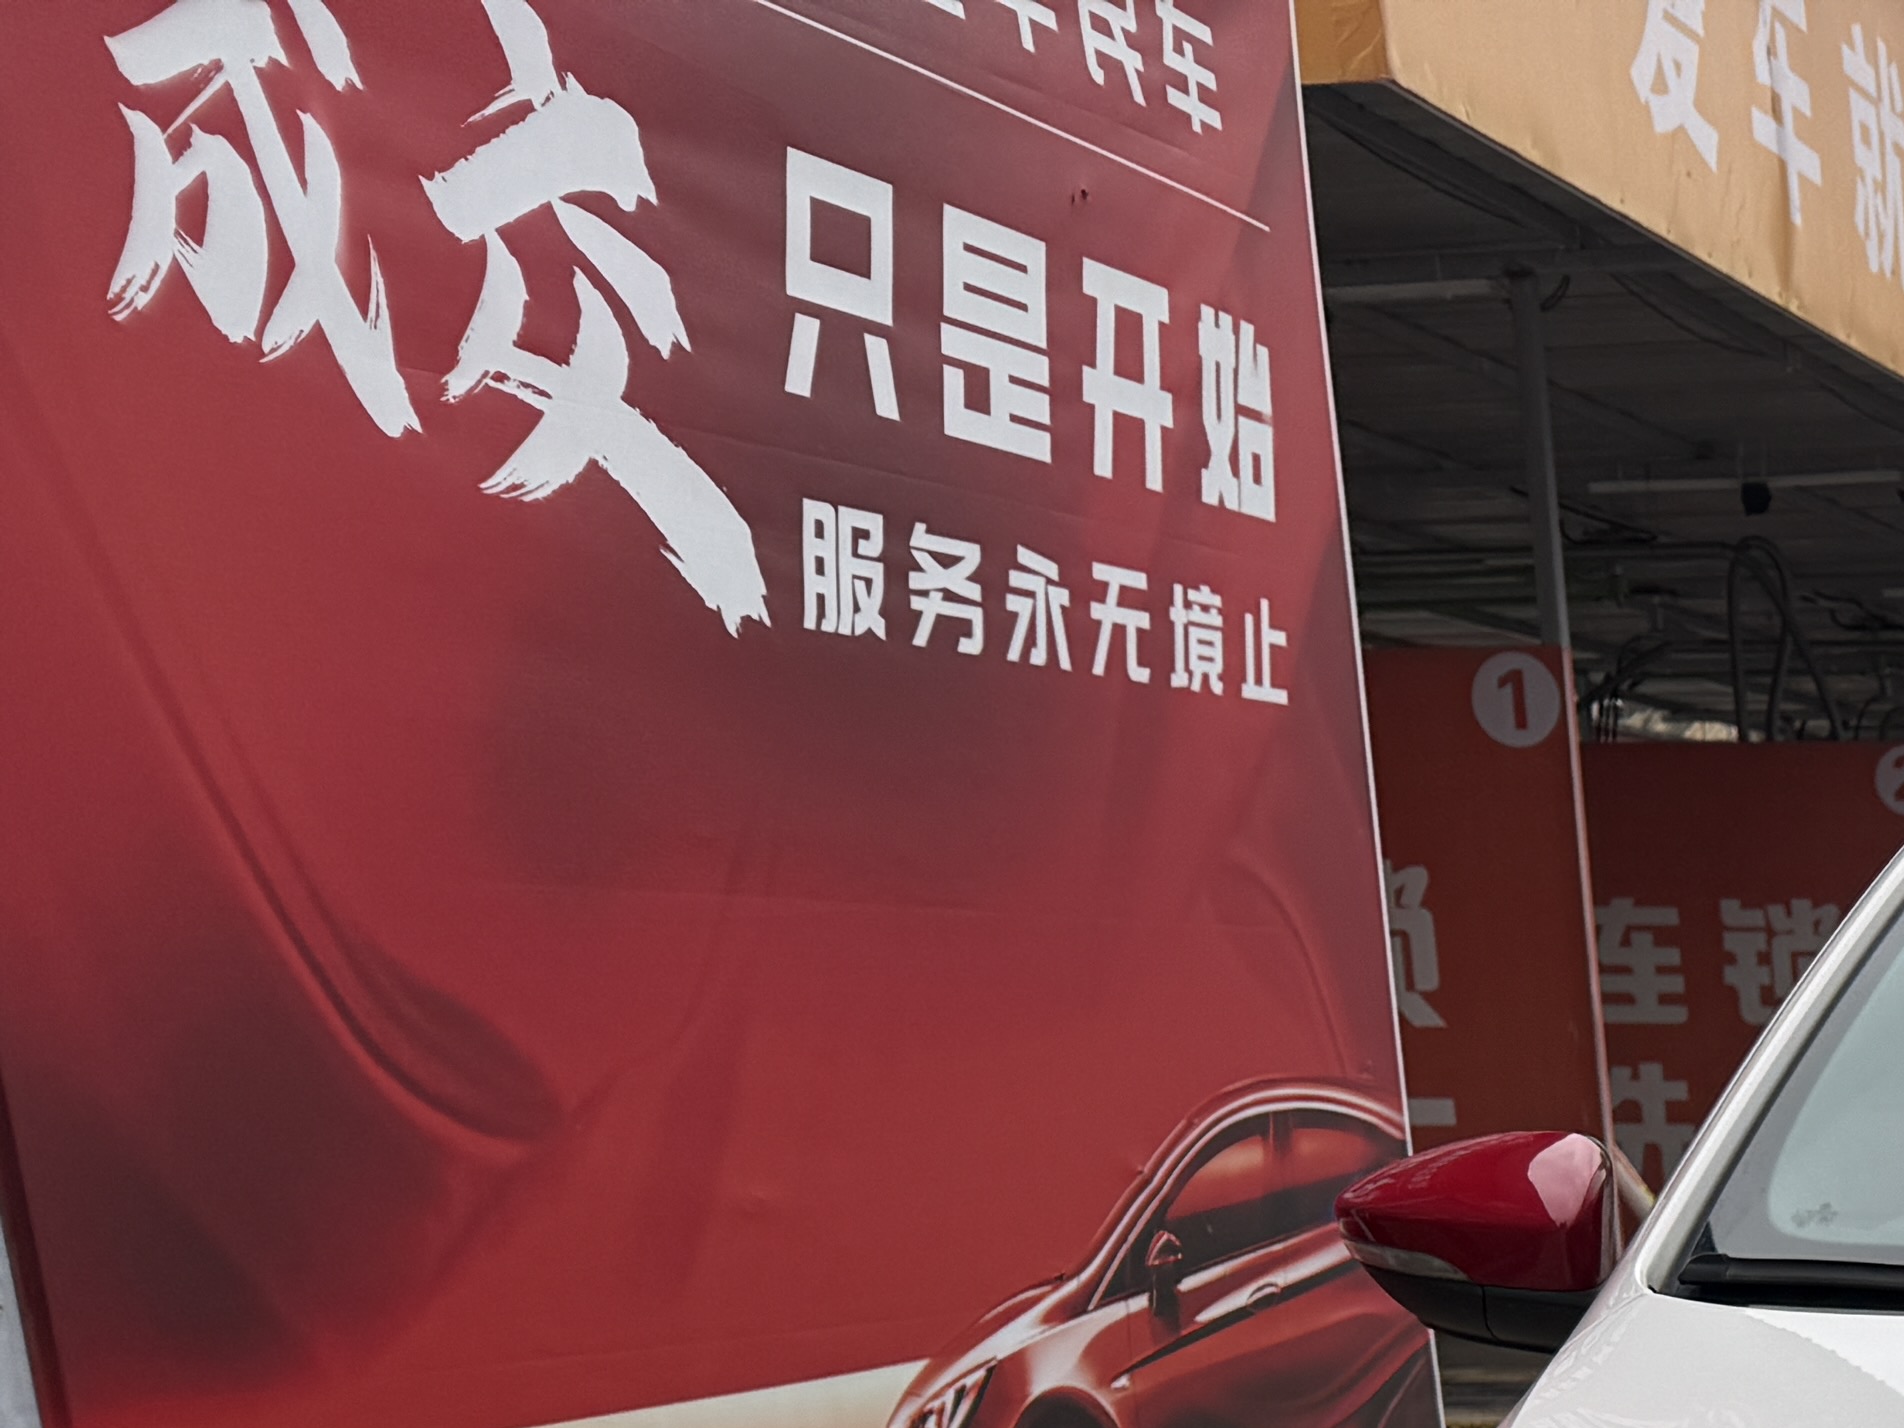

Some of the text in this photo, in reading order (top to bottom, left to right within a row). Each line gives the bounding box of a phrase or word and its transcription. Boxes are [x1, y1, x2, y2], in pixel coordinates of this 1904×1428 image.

[104, 0, 771, 638] 成交
[784, 145, 1277, 523] 只是开始
[800, 496, 1289, 706] 服务永无境止
[1496, 668, 1529, 731] 1
